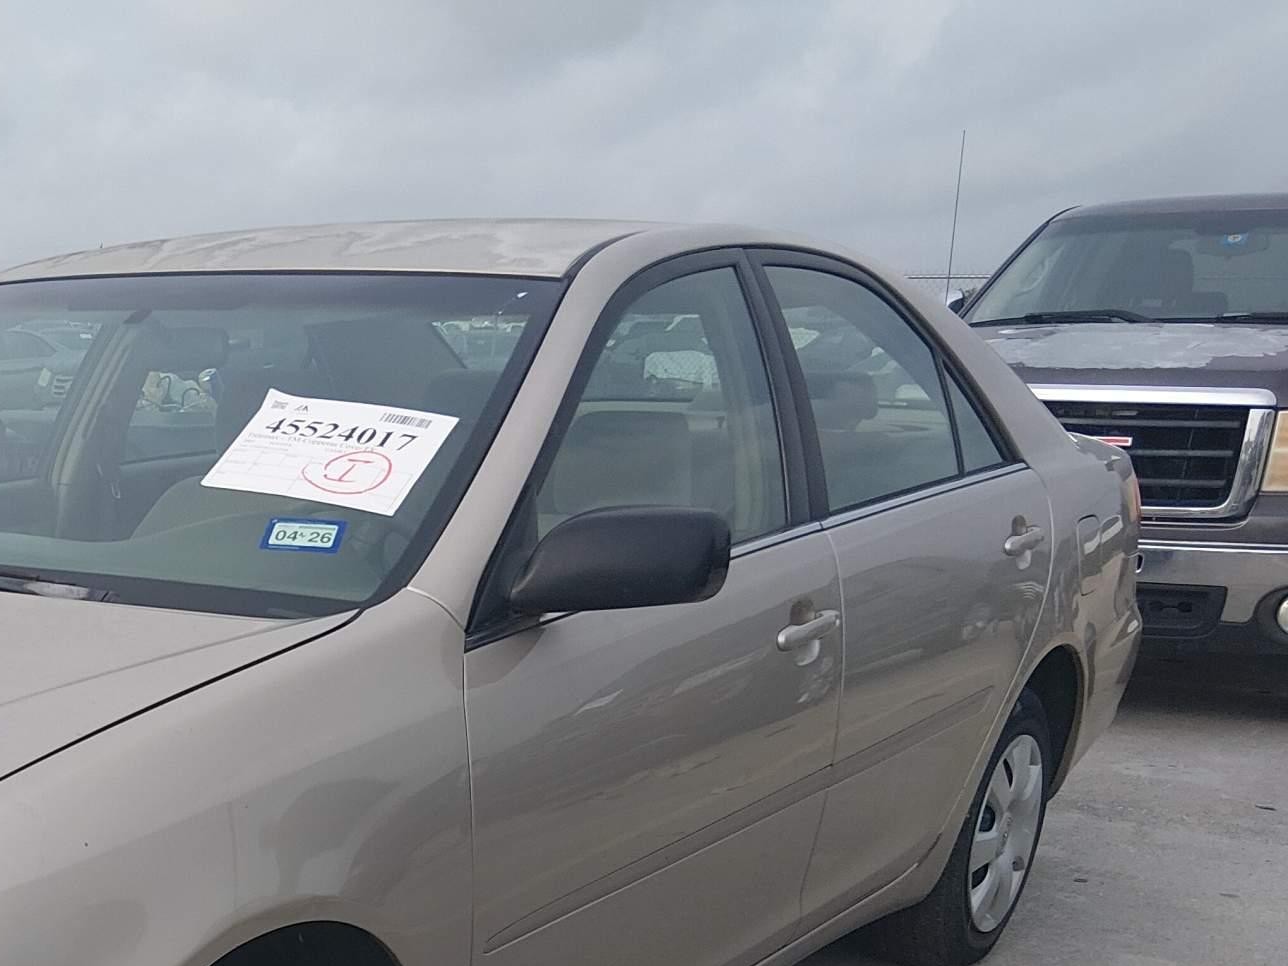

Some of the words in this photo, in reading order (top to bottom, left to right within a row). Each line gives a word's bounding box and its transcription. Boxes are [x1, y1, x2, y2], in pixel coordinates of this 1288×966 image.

[265, 417, 419, 451] 45524017
[275, 529, 299, 541] 04
[308, 531, 333, 544] 26
